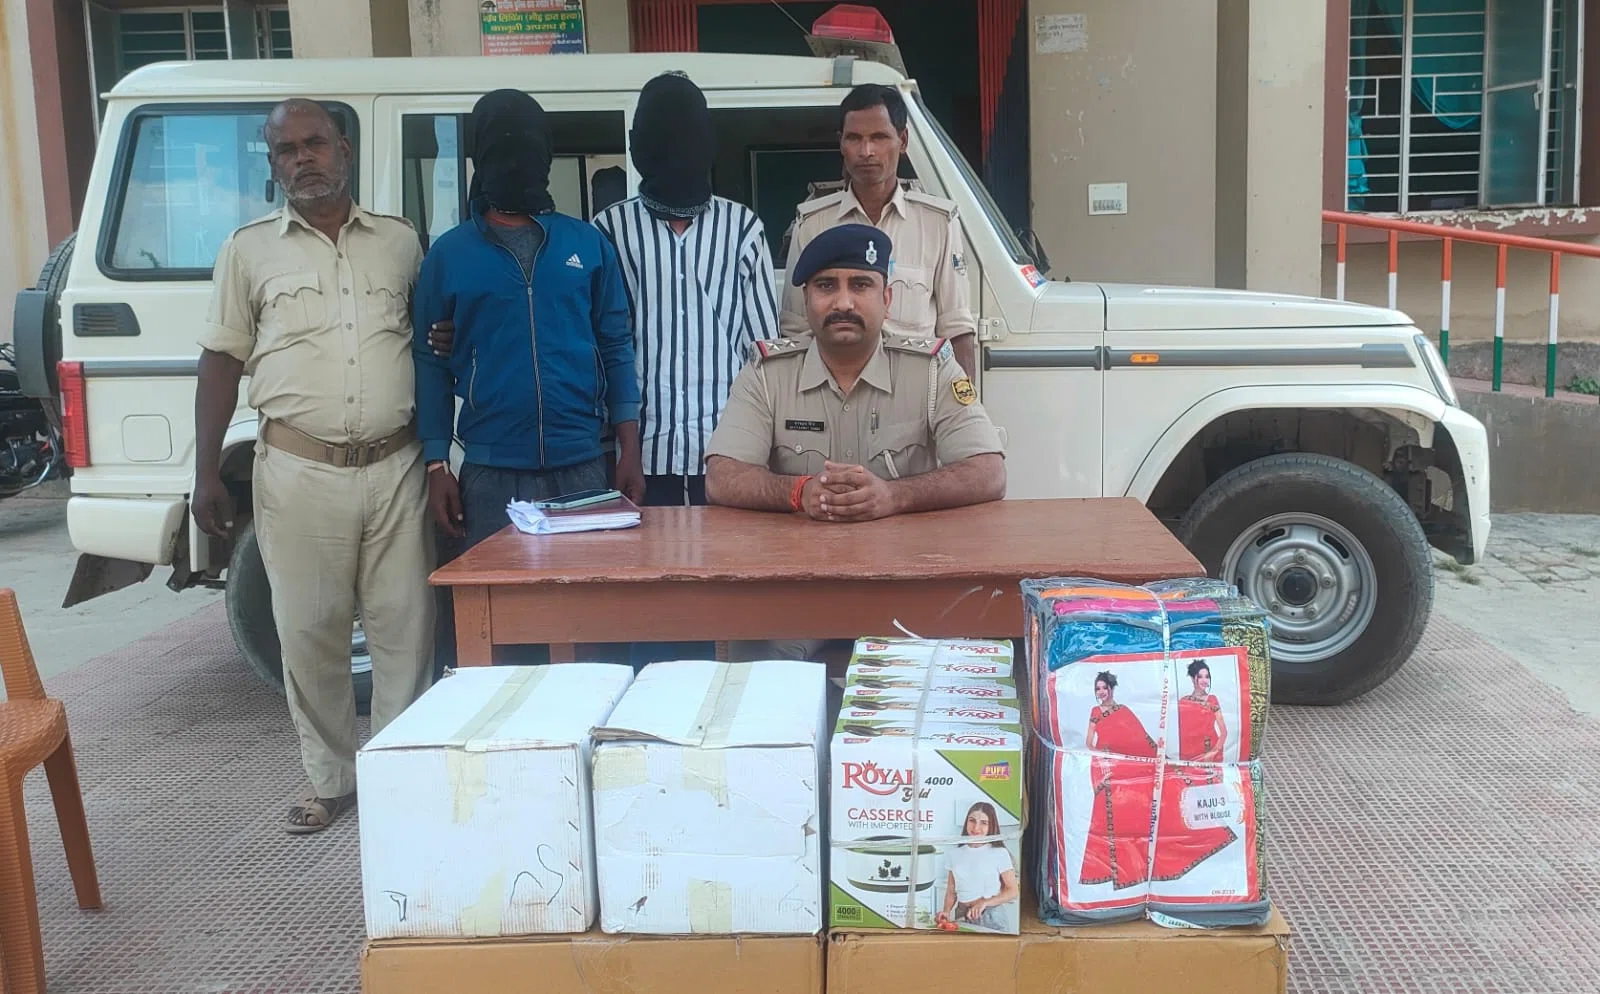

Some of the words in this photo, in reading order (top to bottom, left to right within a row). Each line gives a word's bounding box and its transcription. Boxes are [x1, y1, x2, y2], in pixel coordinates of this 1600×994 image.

[924, 776, 954, 786] 4000
[901, 787, 932, 802] Gld
[1197, 797, 1226, 808] KAJU-3
[848, 820, 869, 830] WITH
[837, 907, 856, 915] 4000
